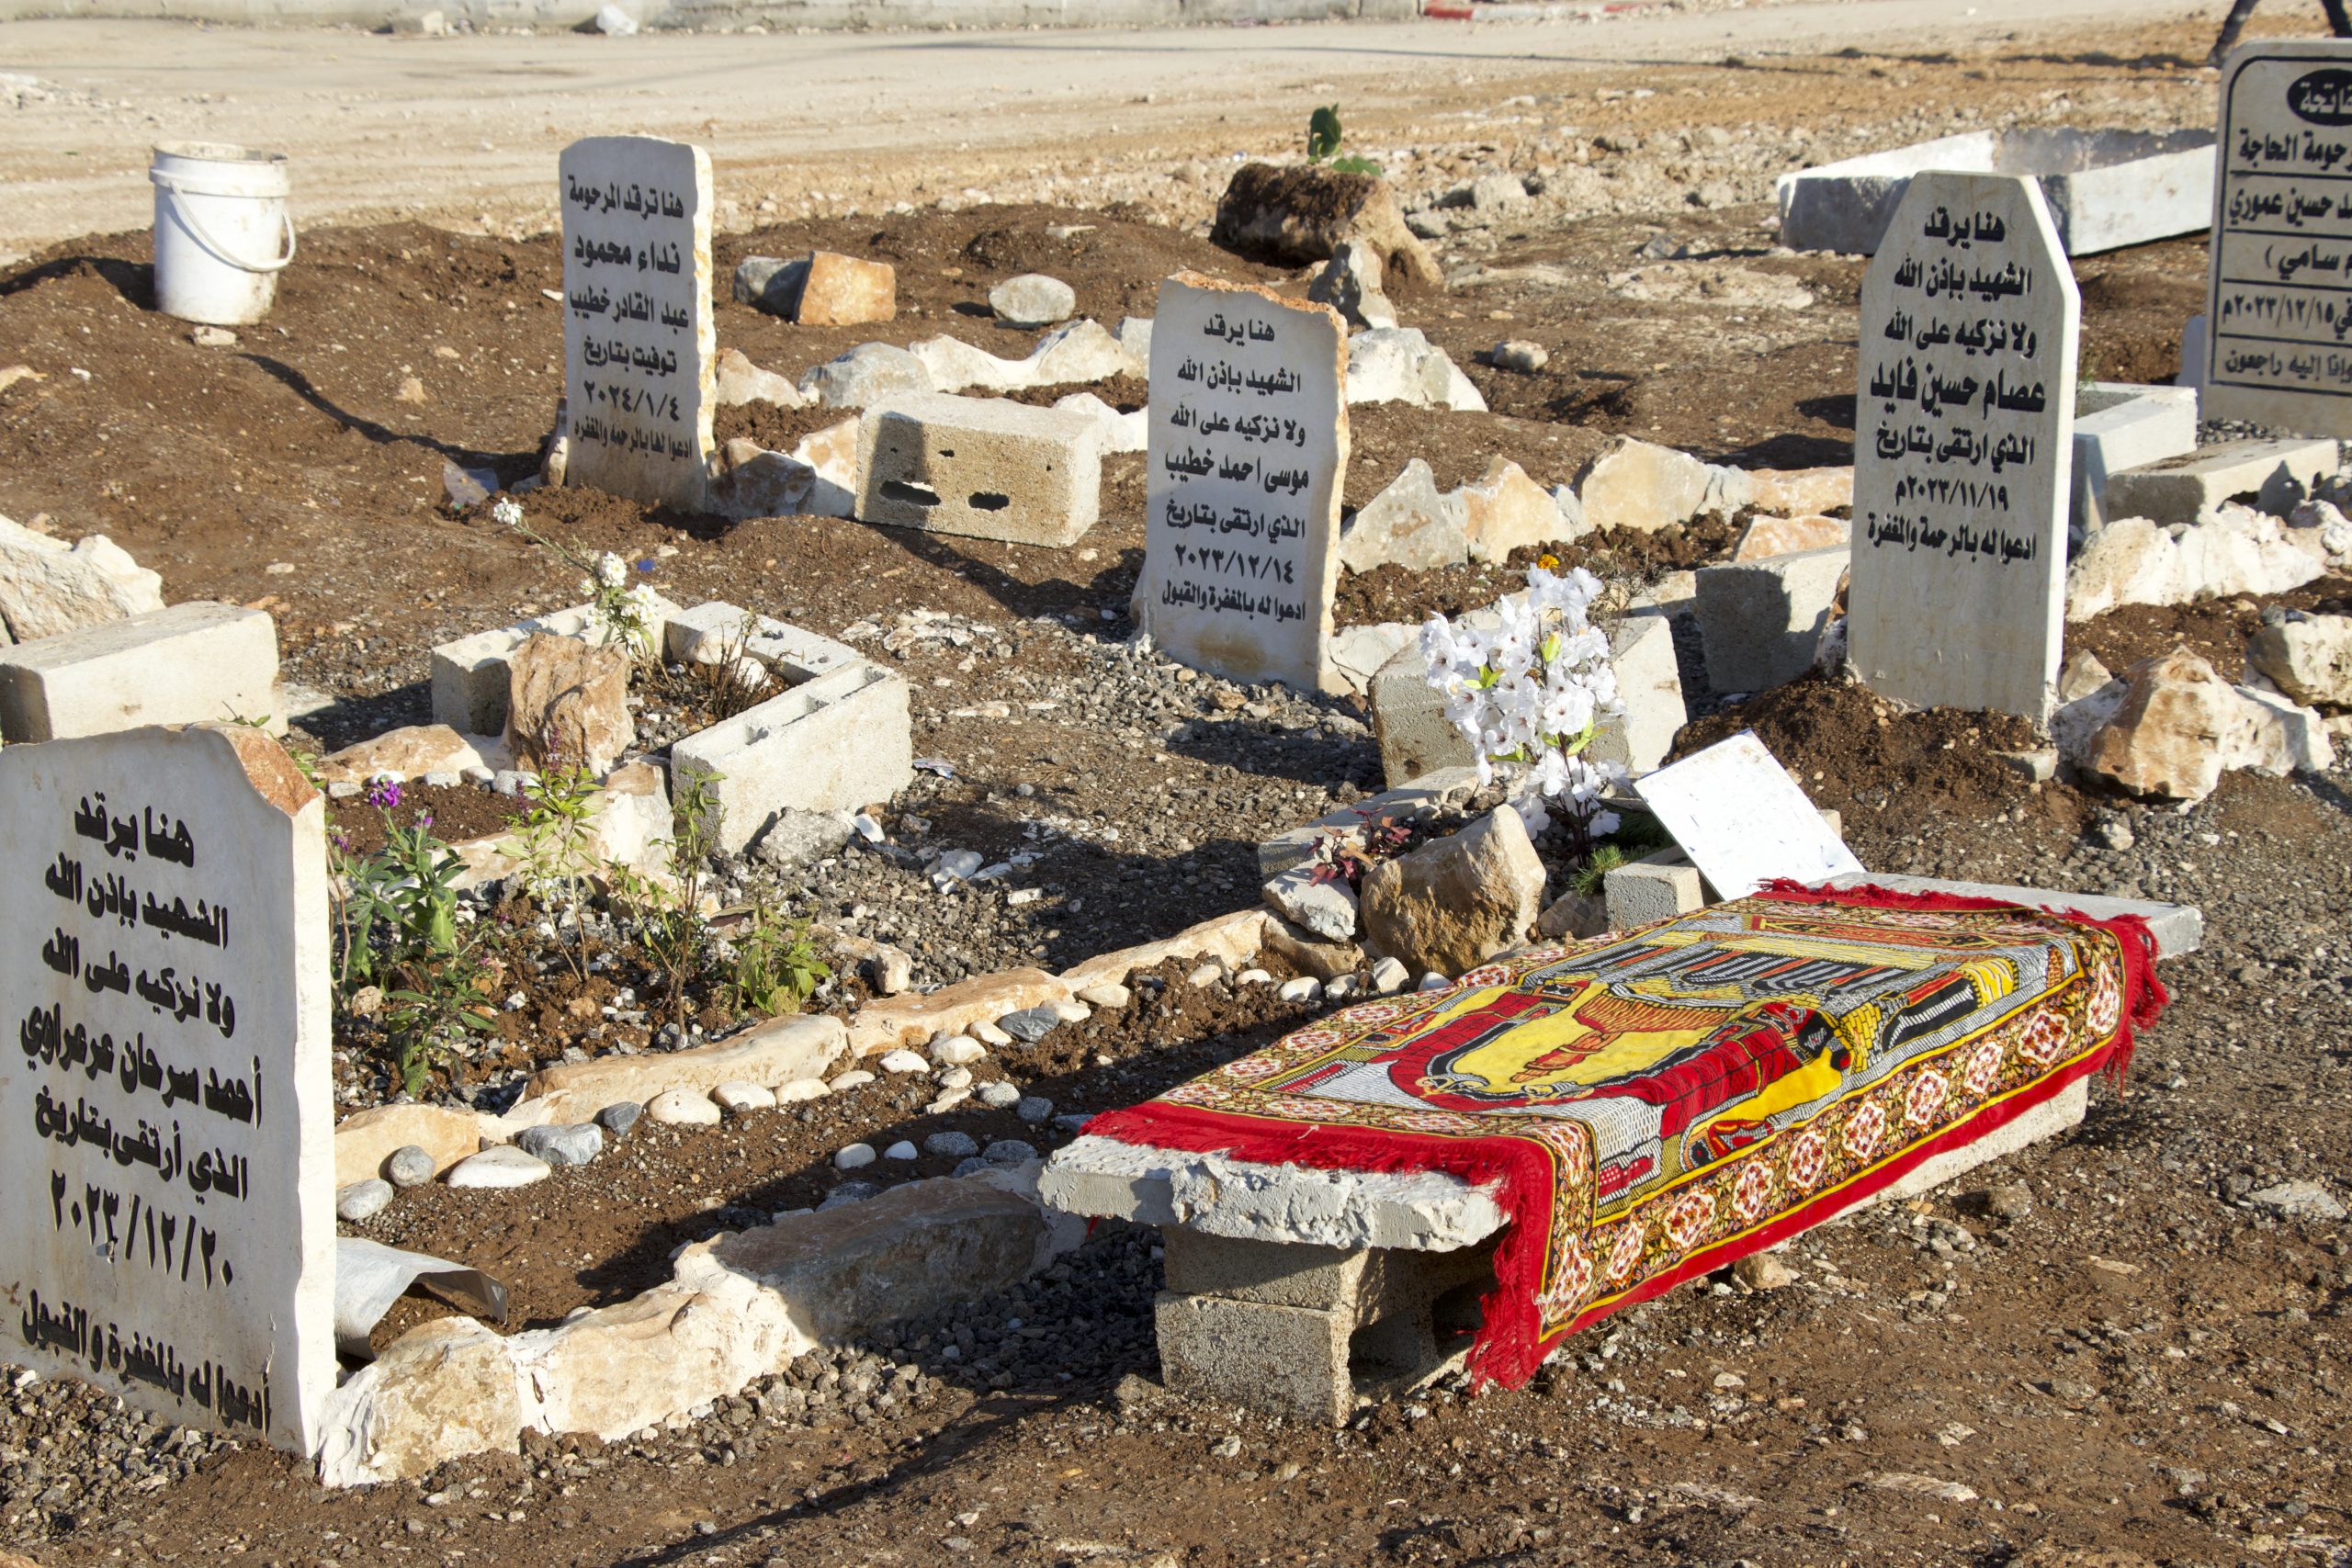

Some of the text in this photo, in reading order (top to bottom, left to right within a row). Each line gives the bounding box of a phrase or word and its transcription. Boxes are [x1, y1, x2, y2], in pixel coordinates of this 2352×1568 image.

[2300, 81, 2352, 114] فاتحة
[2239, 128, 2352, 172] حومة الحاجة
[568, 175, 684, 219] هنا ترقد المرحومة
[1924, 206, 2006, 250] هنا يرقد
[574, 235, 680, 274] نداء محمود
[1894, 252, 1923, 288] الله
[1969, 261, 2032, 303] الشهيد
[570, 285, 688, 335] عبد القادر خطيب
[1204, 314, 1274, 345] هنا يرقد
[1884, 306, 2037, 359] ولا نزكيه على الله
[584, 335, 677, 377] توفيت بتاريخ
[1178, 355, 1204, 382] الله
[1246, 367, 1301, 397] الشهيد
[1870, 355, 2046, 420] عصام حسين فايد
[650, 429, 665, 453] لها
[1170, 401, 1306, 447] ولا نزكيه على الله
[1876, 420, 2035, 474] الذي ارتقى بتاريخ
[669, 434, 692, 461] ادعوا
[1165, 446, 1309, 494] موسى احمد خطيب
[1166, 499, 1306, 544] الذي ارتقى بتاريخ
[1868, 511, 2037, 565] ادعوا له بالرحمة والمغفرة
[1162, 580, 1306, 623] ادعوا له بالمغفرة والقبول
[74, 791, 194, 868] هنا يرقد
[45, 851, 82, 905] الله
[141, 890, 228, 951] الشهيد
[42, 927, 235, 1039] ولا نزكيه على الله
[20, 1002, 262, 1131] أحمد سرحان عرعراوي
[35, 1085, 112, 1159] بتاريخ
[187, 1147, 247, 1206] الذي
[107, 1323, 185, 1408] بالمغفرة
[188, 1360, 211, 1408] له
